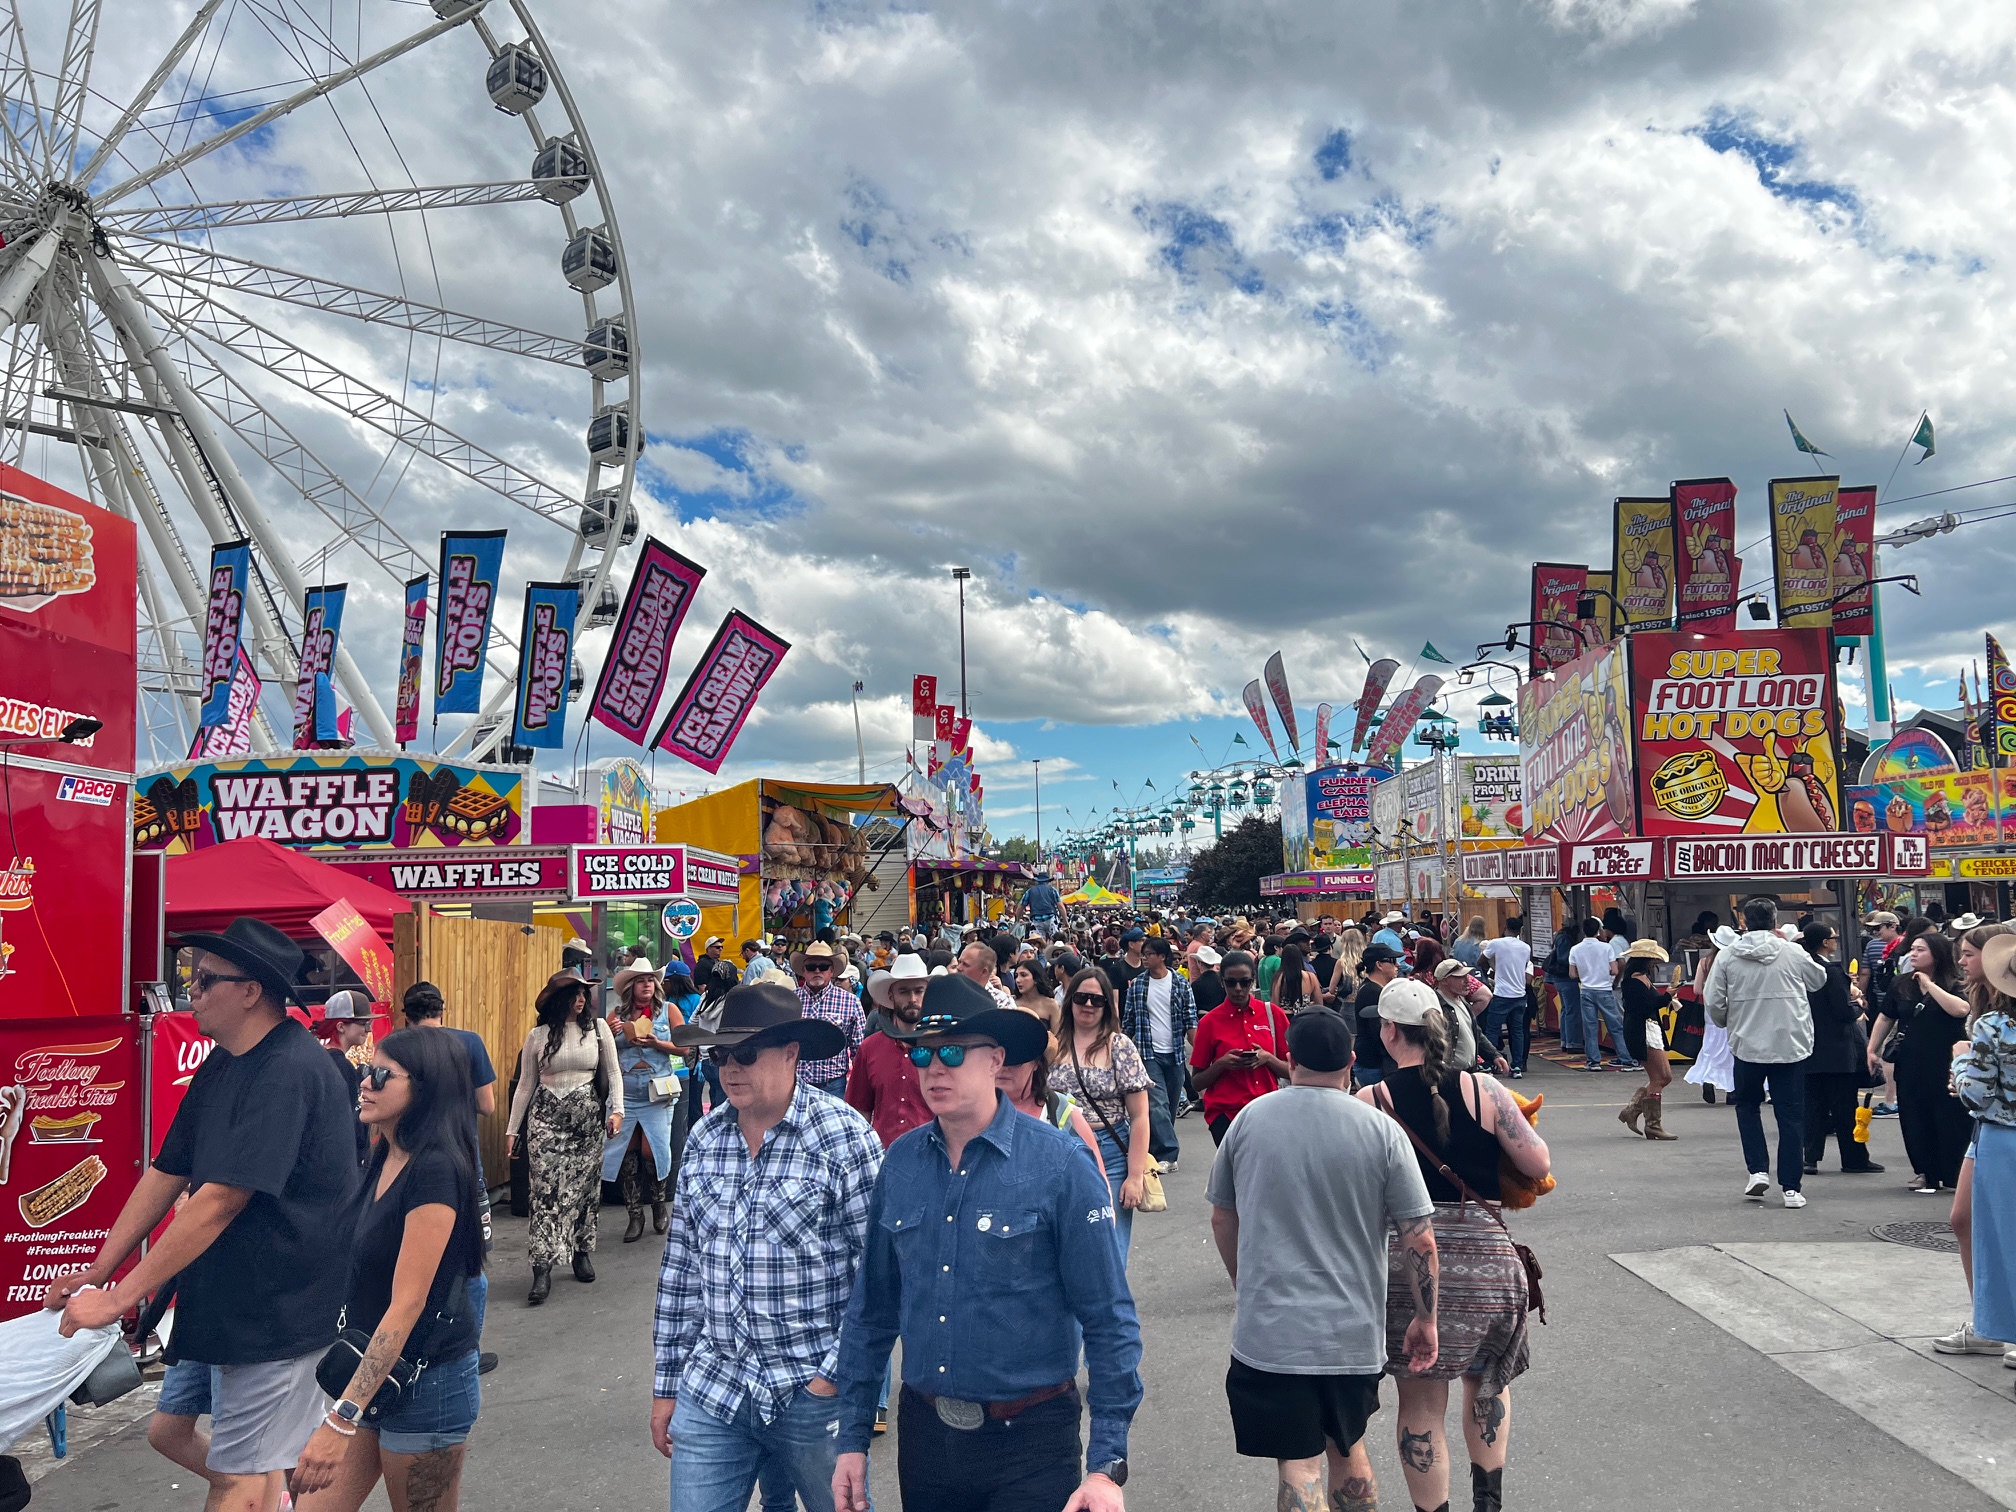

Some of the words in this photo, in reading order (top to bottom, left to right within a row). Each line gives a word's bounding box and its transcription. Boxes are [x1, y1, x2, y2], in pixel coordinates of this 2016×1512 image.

[1690, 498, 1707, 508] The
[1777, 491, 1833, 514] Original
[1785, 491, 1804, 502] The
[1631, 514, 1648, 524] The
[1683, 498, 1732, 520] Original
[1624, 515, 1672, 536] Original
[1542, 581, 1580, 596] Original
[1547, 578, 1559, 586] The
[1688, 573, 1729, 584] SUPER
[1626, 585, 1665, 597] SUPER
[624, 566, 666, 665] CREAM
[1685, 612, 1705, 620] since
[1704, 607, 1728, 617] 1957
[1800, 602, 1826, 613] 1957
[1840, 608, 1866, 620] 1957
[202, 570, 232, 699] WAFFLE
[213, 594, 240, 679] POPS
[441, 557, 474, 695] WAFFLE
[453, 582, 489, 668] POPS
[1640, 621, 1663, 630] 1957
[622, 580, 685, 724] SANDWICH
[1666, 647, 1782, 679] SUPER
[294, 611, 323, 726] WAFFLE
[527, 605, 553, 726] WAFFLE
[544, 629, 567, 711] POPS
[697, 633, 750, 712] CREAM
[602, 663, 634, 713] ICE
[1656, 681, 1735, 711] FOOT
[1737, 678, 1818, 708] LONG
[699, 648, 771, 755] SANDWICH
[1537, 671, 1583, 748] SUPER
[674, 703, 706, 748] ICE
[1641, 710, 1721, 741] HOT
[1723, 709, 1827, 740] DOGS
[1526, 748, 1555, 798] FOOT
[1554, 714, 1587, 776] LONG
[71, 779, 114, 800] pace
[214, 774, 395, 808] WAFFLE
[1318, 776, 1378, 788] FUNNEL
[1322, 786, 1368, 796] CAKE
[1473, 784, 1505, 797] FROM
[1531, 785, 1562, 841] HOT
[1564, 736, 1612, 815] DOGS
[1659, 789, 1679, 802] THE
[1679, 777, 1722, 796] ORIGINAL
[217, 806, 390, 839] WAGON
[611, 808, 643, 834] WAFFLE
[1333, 808, 1370, 819] EARS
[611, 827, 643, 844] WAGON
[584, 855, 619, 872] ICE
[624, 854, 676, 871] COLD
[1534, 851, 1545, 877] HOT
[1545, 850, 1556, 877] DOG
[1591, 845, 1630, 861] 100%
[1678, 843, 1691, 873] DBL
[1692, 843, 1747, 872] BACON
[1752, 841, 1791, 871] MAC
[1909, 852, 1924, 868] BEEF
[391, 861, 541, 889] WAFFLES
[698, 865, 717, 884] CREAM
[717, 869, 738, 888] WAFFLES
[1577, 860, 1604, 876] ALL
[1606, 857, 1644, 875] BEEF
[590, 872, 670, 891] DRINKS
[1324, 876, 1361, 885] FUNNEL
[15, 1045, 105, 1086] Footlong
[79, 1083, 119, 1108] Fries
[26, 1244, 97, 1257] #FreakkFries
